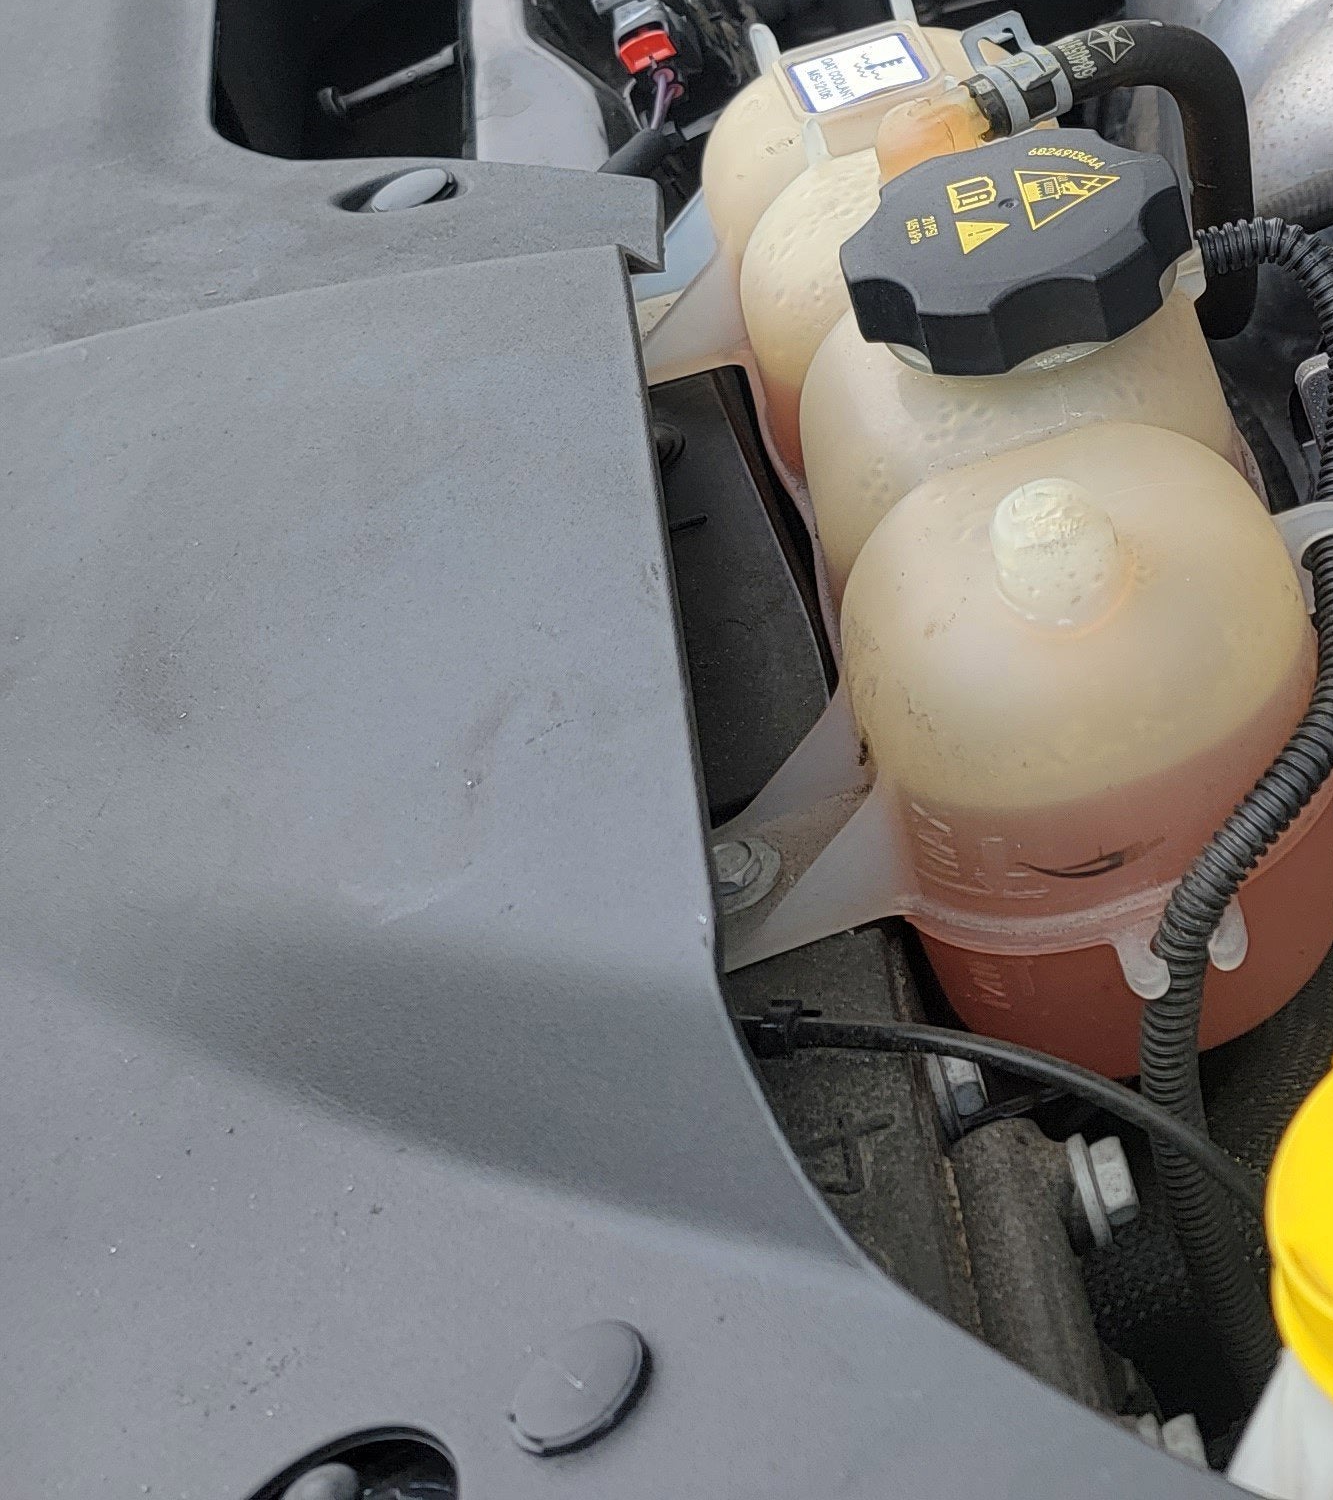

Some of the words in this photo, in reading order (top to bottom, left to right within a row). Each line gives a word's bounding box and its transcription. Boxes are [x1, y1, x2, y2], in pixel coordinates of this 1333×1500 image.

[821, 58, 839, 71] OAT
[829, 70, 856, 101] COOLANT
[922, 215, 936, 226] 21
[923, 223, 939, 238] PSI
